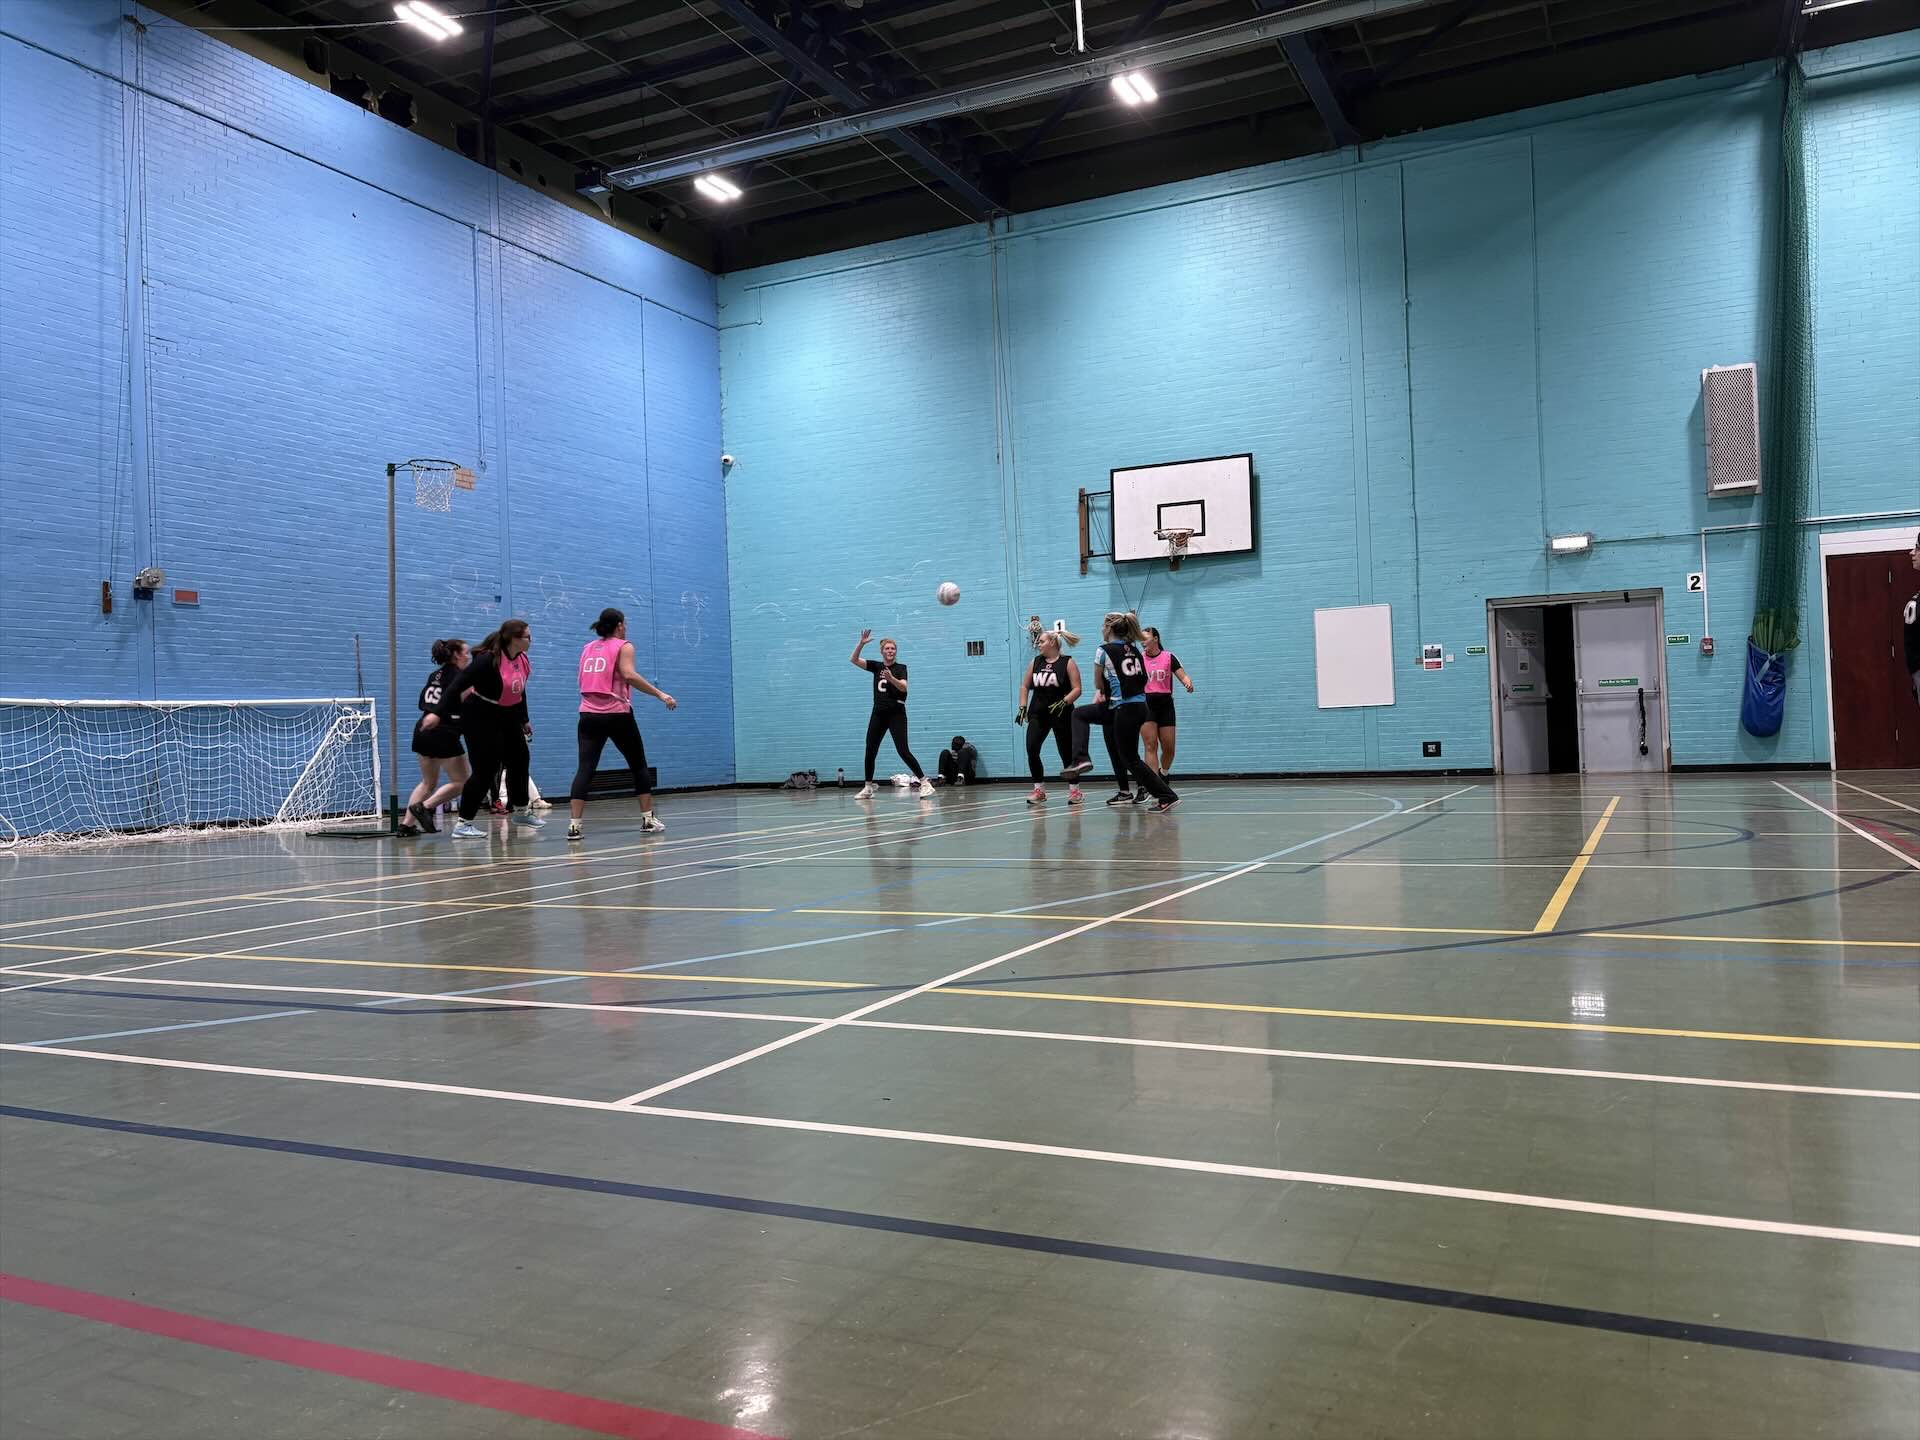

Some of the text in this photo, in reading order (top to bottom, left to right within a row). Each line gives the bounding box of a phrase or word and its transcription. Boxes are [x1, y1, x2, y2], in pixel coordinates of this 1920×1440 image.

[1690, 575, 1702, 591] 2
[1056, 621, 1062, 631] 1
[583, 656, 607, 673] GD
[1121, 657, 1143, 676] GA
[877, 679, 888, 692] C
[1032, 672, 1060, 687] WA
[424, 685, 442, 704] GS
